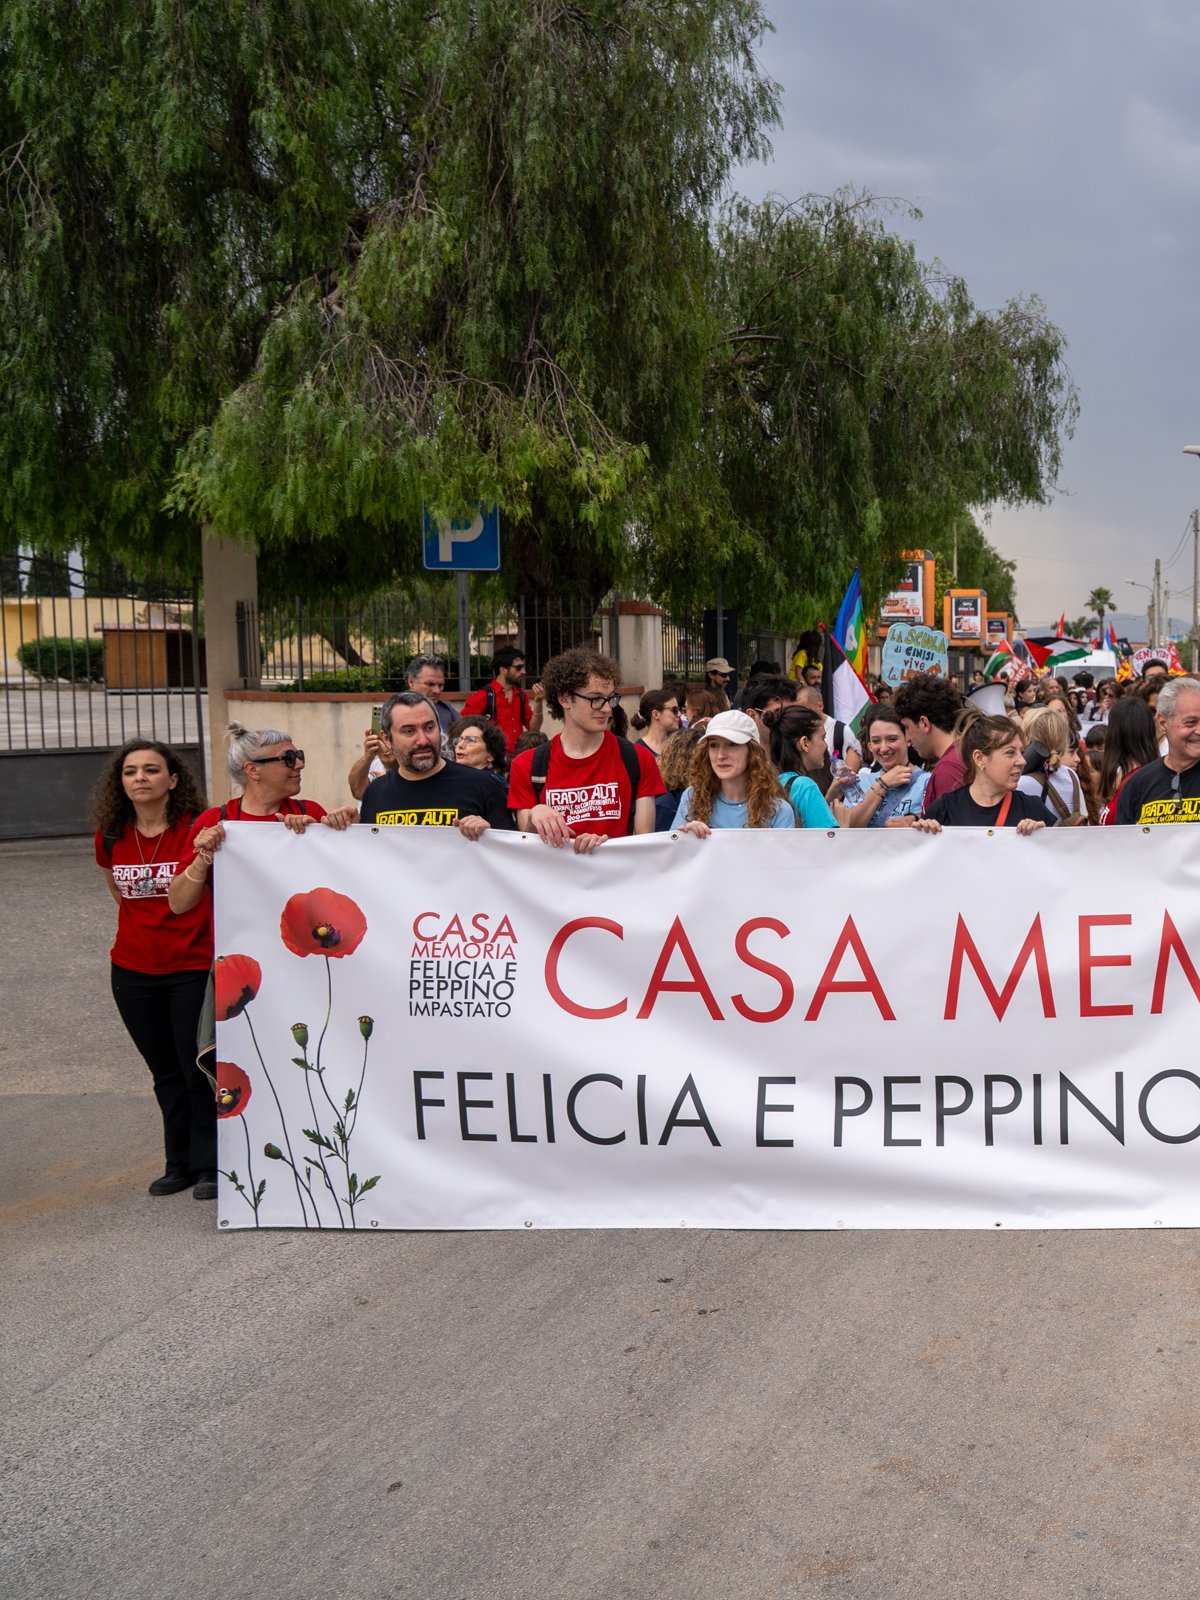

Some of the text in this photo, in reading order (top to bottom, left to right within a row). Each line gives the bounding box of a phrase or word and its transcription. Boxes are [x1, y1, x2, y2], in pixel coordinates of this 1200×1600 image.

[904, 628, 946, 654] SCUOLA
[894, 645, 935, 662] di CINISI
[903, 657, 926, 671] vive
[551, 784, 618, 806] RADIO AUT
[379, 811, 455, 825] RADIO AUT
[1145, 802, 1176, 817] RADIO
[115, 867, 153, 881] RADIO
[412, 911, 518, 943] CASA
[410, 941, 517, 960] MEMORIA
[409, 960, 518, 981] FELICIA E
[545, 914, 897, 1023] CASA
[408, 979, 515, 1001] PEPPINO
[408, 1001, 512, 1018] IMPASTATO
[412, 1070, 722, 1147] FELICIA
[755, 1076, 796, 1148] E
